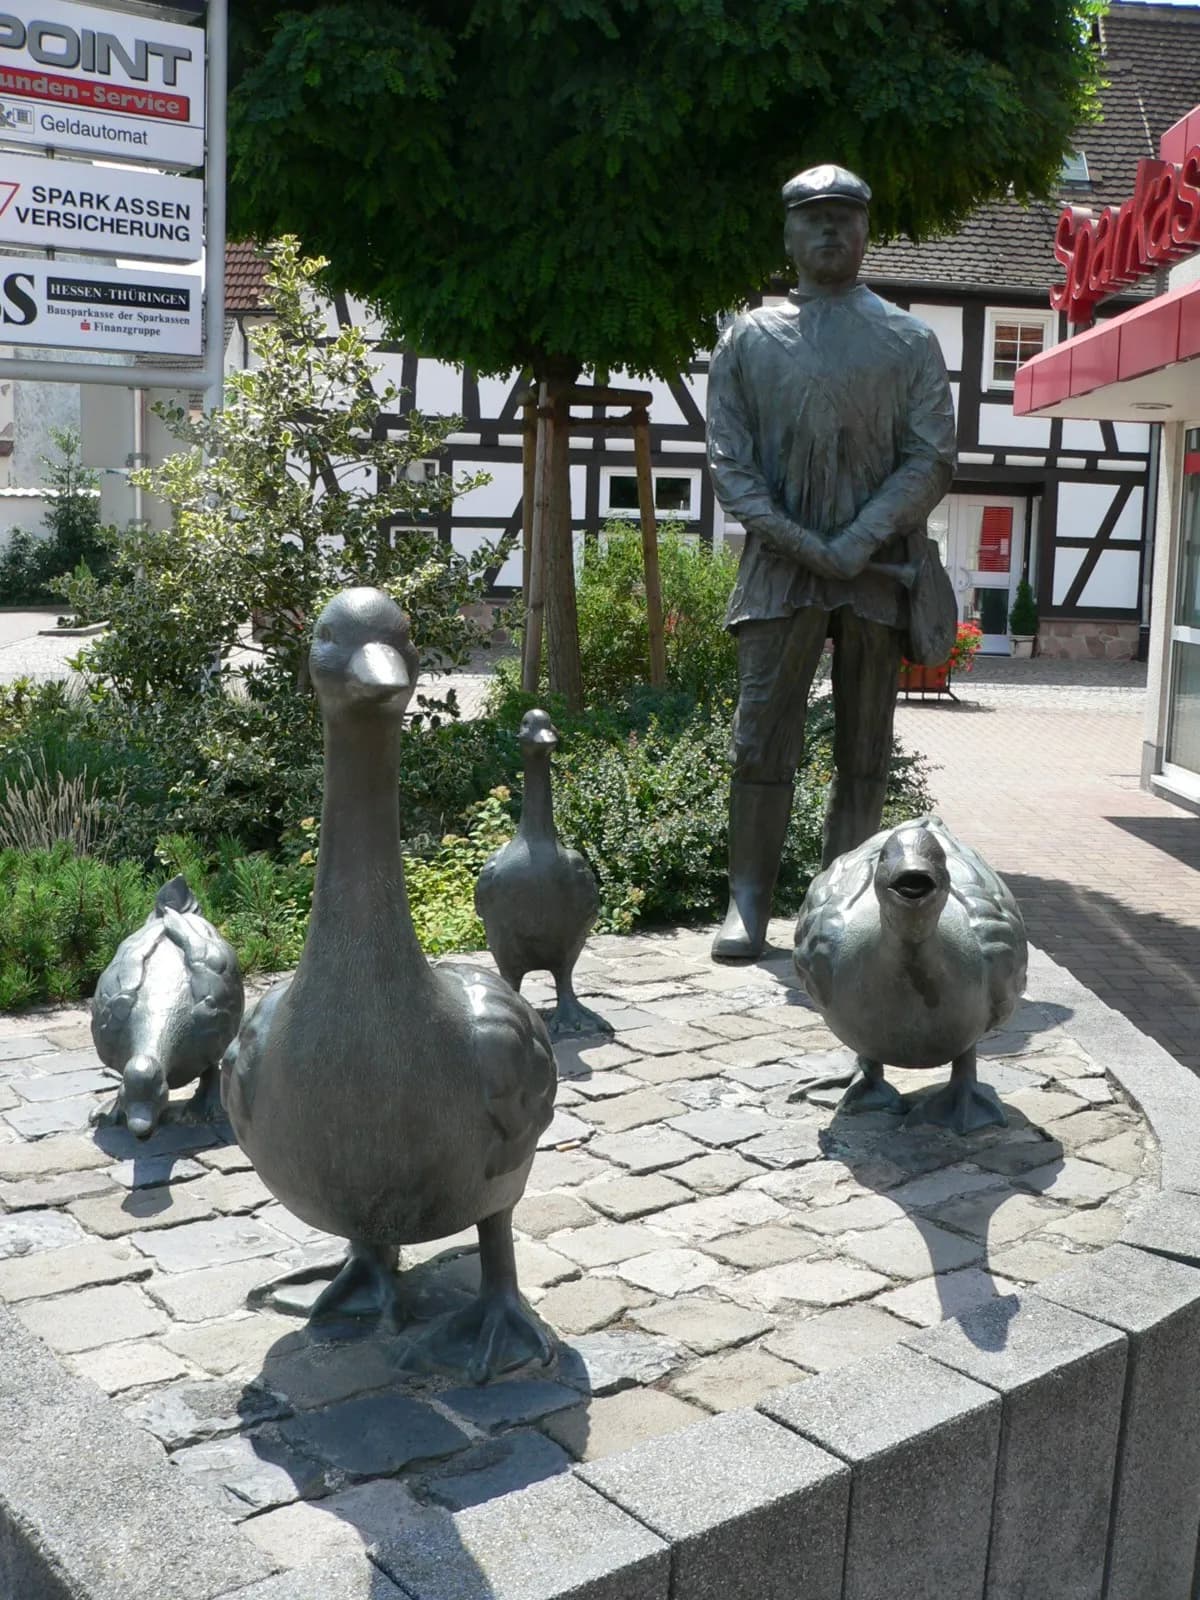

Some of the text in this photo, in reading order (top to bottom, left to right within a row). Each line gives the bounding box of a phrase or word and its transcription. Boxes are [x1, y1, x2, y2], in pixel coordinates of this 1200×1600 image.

[0, 13, 192, 86] POINT
[40, 114, 148, 145] Geldautomat
[32, 185, 190, 221] SPARKASSEN
[15, 206, 190, 242] VERSICHERUNG
[47, 305, 190, 326] Bausparkasse der Sparkassen
[94, 321, 161, 337] Finanzgruppe
